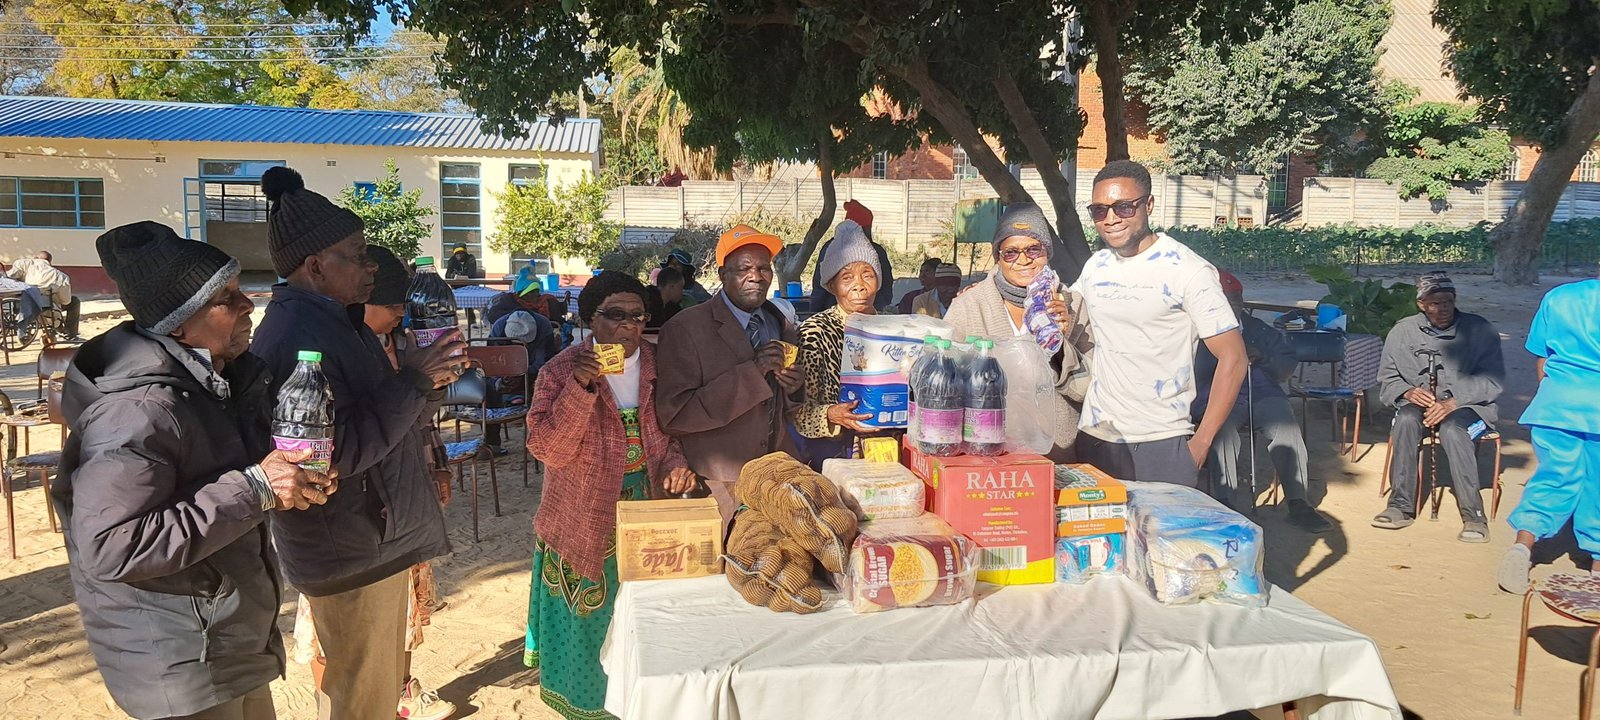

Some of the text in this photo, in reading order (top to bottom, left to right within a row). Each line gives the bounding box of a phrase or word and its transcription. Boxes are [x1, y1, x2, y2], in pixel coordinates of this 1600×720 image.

[881, 343, 924, 362] Kitten Sof
[966, 470, 1035, 490] RAHA
[986, 490, 1016, 500] STAR
[1079, 491, 1105, 499] Monty's
[642, 544, 693, 574] Jade
[943, 546, 954, 571] Sugar
[877, 556, 888, 586] SUGAR
[868, 570, 878, 598] Crstal
